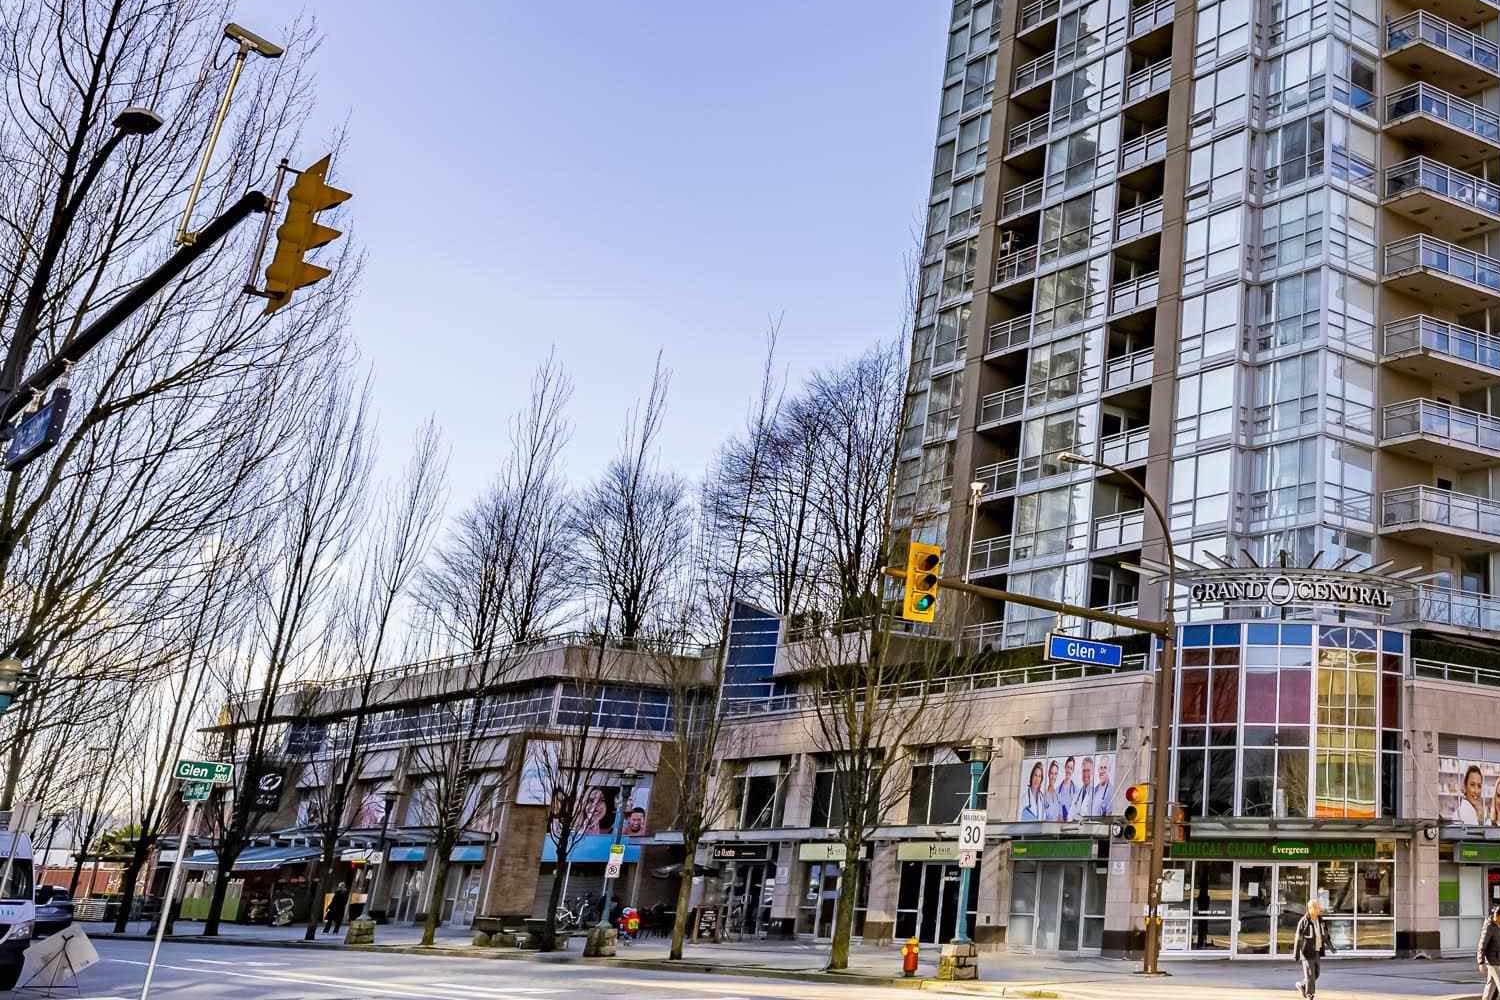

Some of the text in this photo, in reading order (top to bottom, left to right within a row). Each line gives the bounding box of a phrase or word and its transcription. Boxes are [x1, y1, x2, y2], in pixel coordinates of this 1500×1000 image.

[1191, 581, 1264, 602] GRAND
[1297, 582, 1393, 607] CENTRAL
[1067, 642, 1107, 660] Glen Dr
[180, 763, 228, 777] Glen Dr
[964, 825, 981, 844] 30
[1272, 845, 1309, 856] Evergreen
